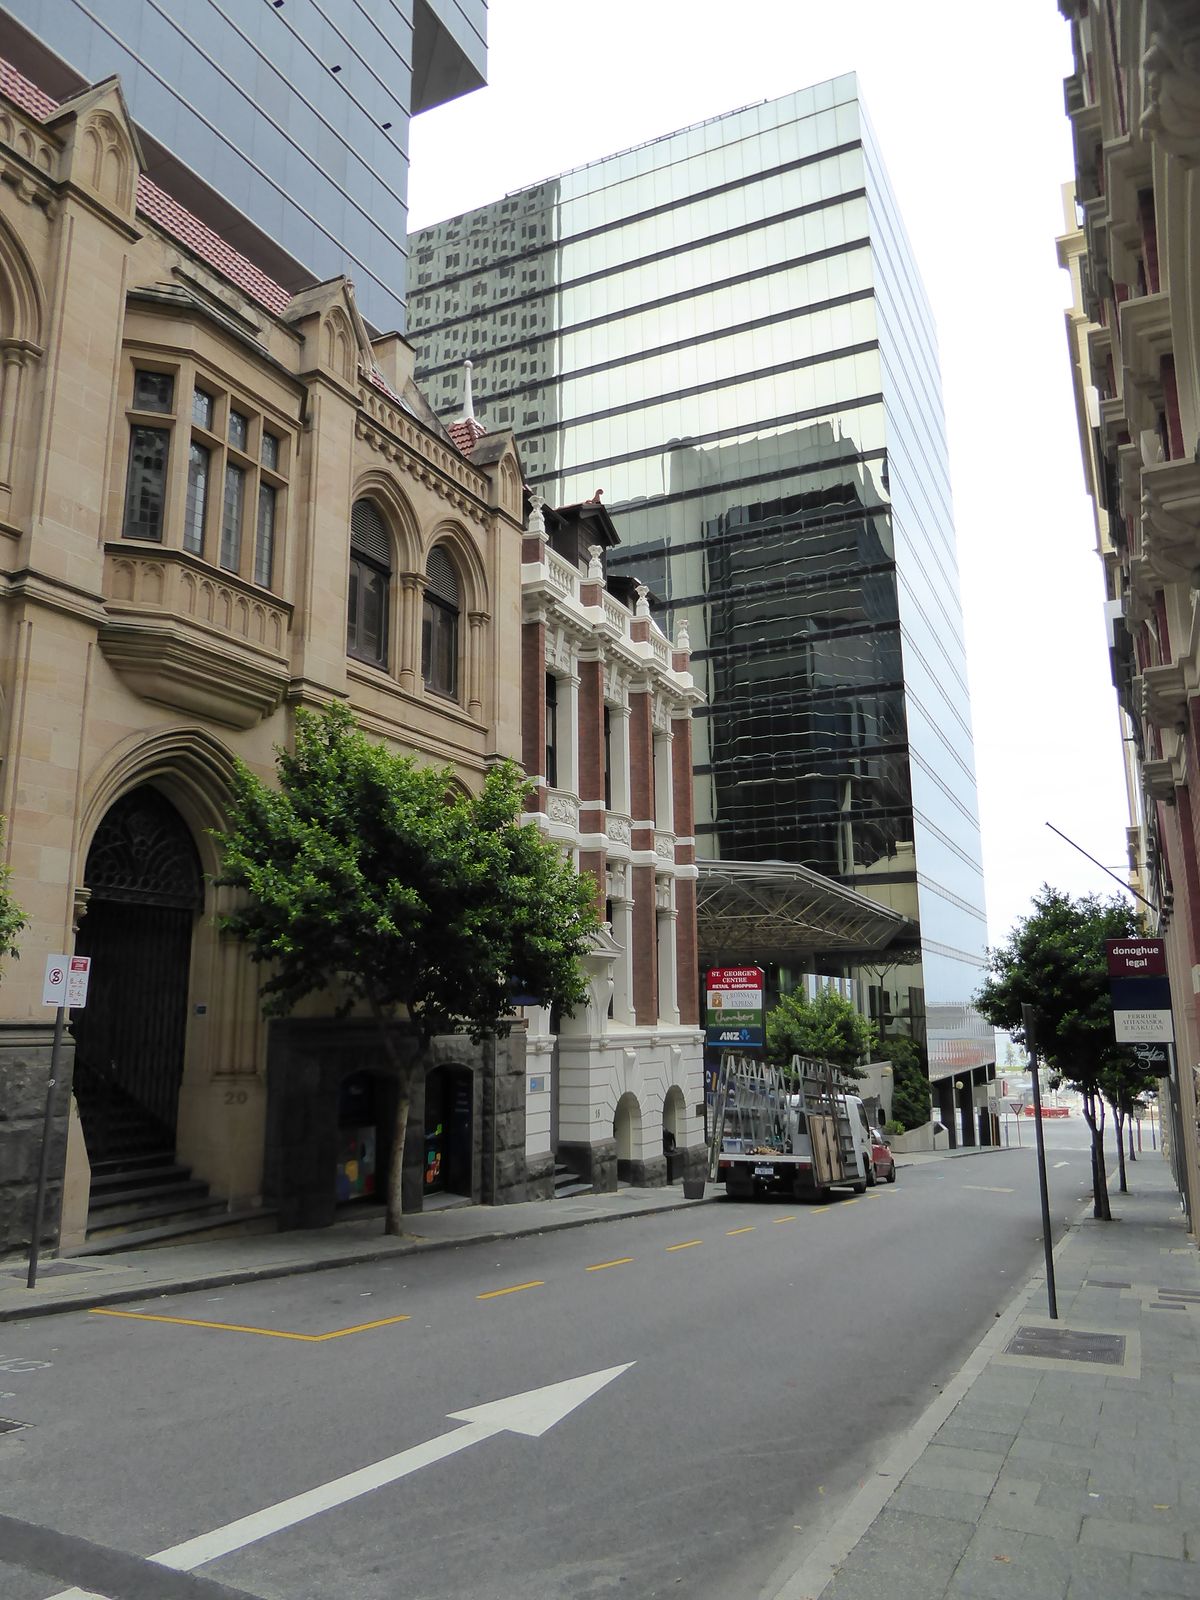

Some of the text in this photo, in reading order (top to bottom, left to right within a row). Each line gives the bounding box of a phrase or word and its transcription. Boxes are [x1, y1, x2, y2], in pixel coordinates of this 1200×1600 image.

[1113, 946, 1159, 956] donoghue
[1126, 958, 1148, 968] legal
[719, 1032, 740, 1040] ANZ
[224, 1091, 248, 1105] 20
